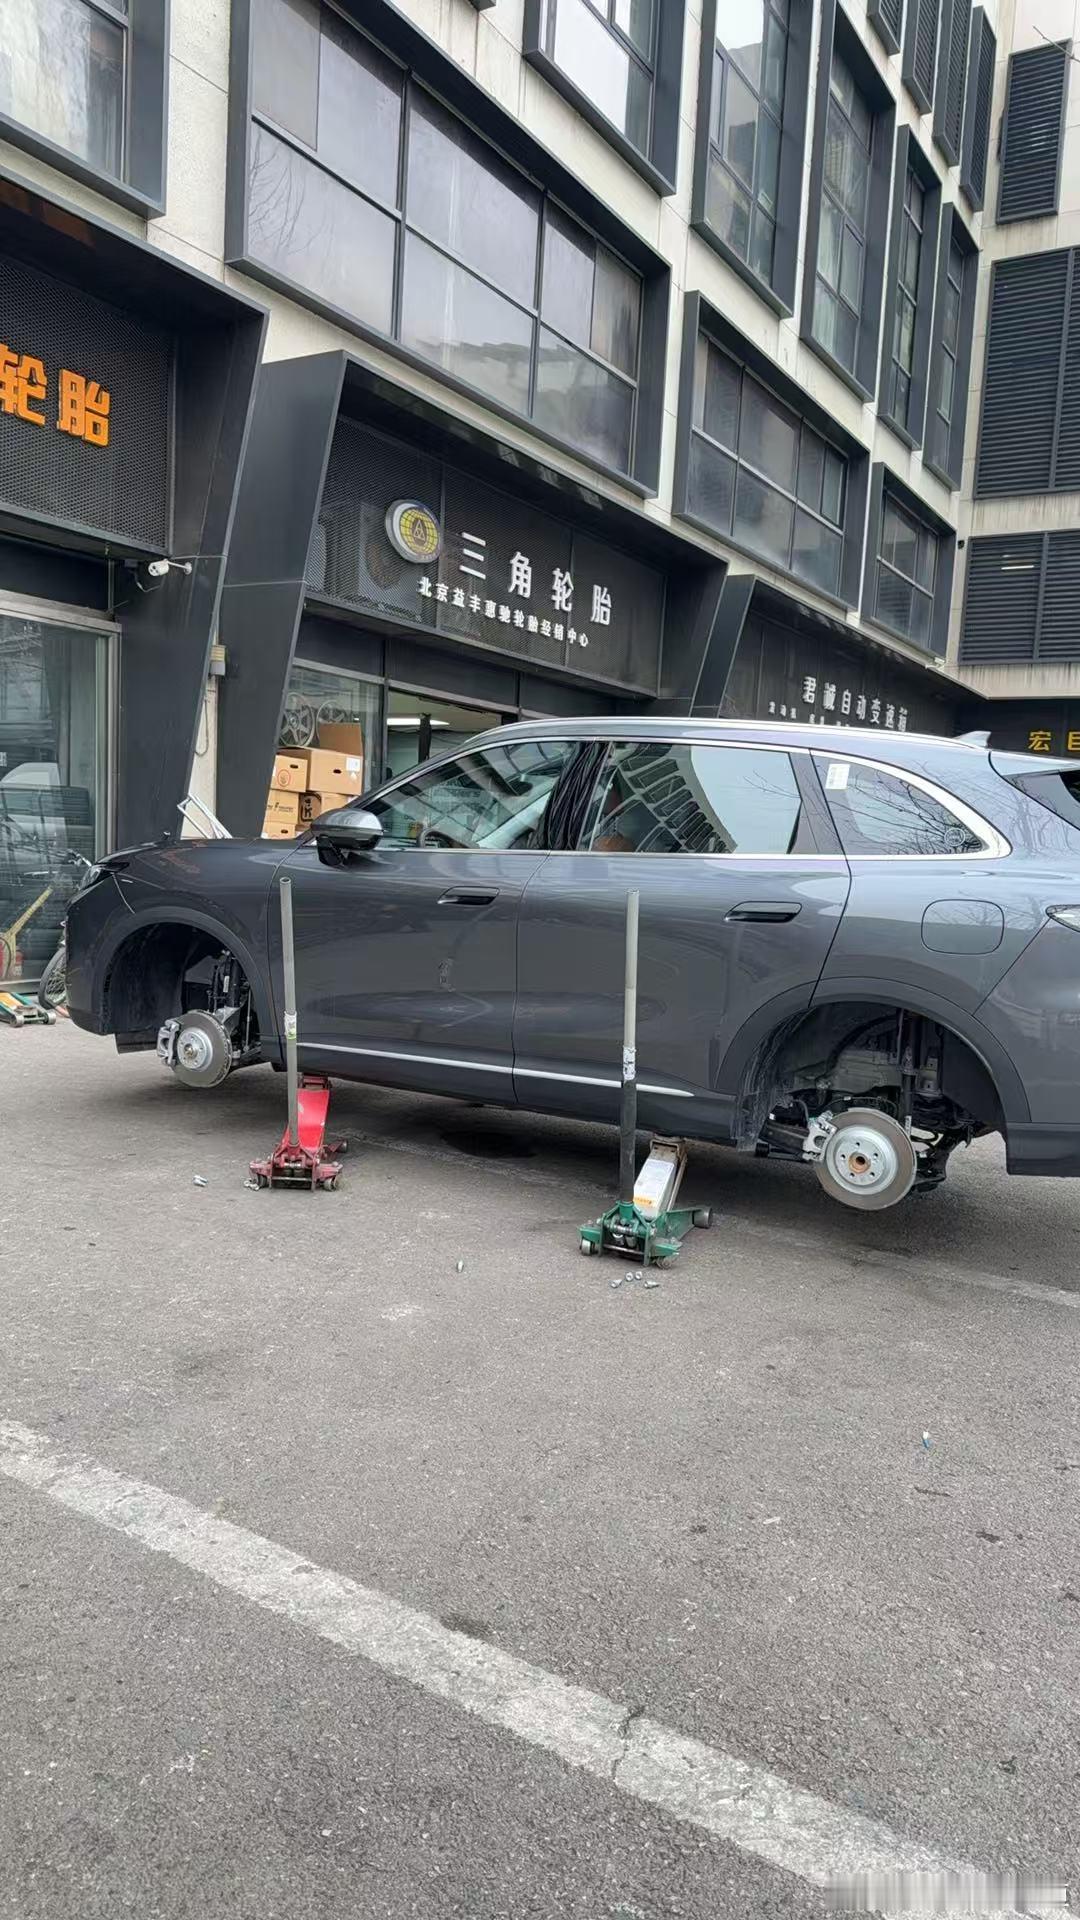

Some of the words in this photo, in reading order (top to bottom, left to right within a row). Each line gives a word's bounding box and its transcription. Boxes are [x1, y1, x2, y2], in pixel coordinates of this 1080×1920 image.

[416, 576, 589, 648] 北京益丰惠驰轮胎经销中心
[458, 531, 613, 626] 三角轮胎
